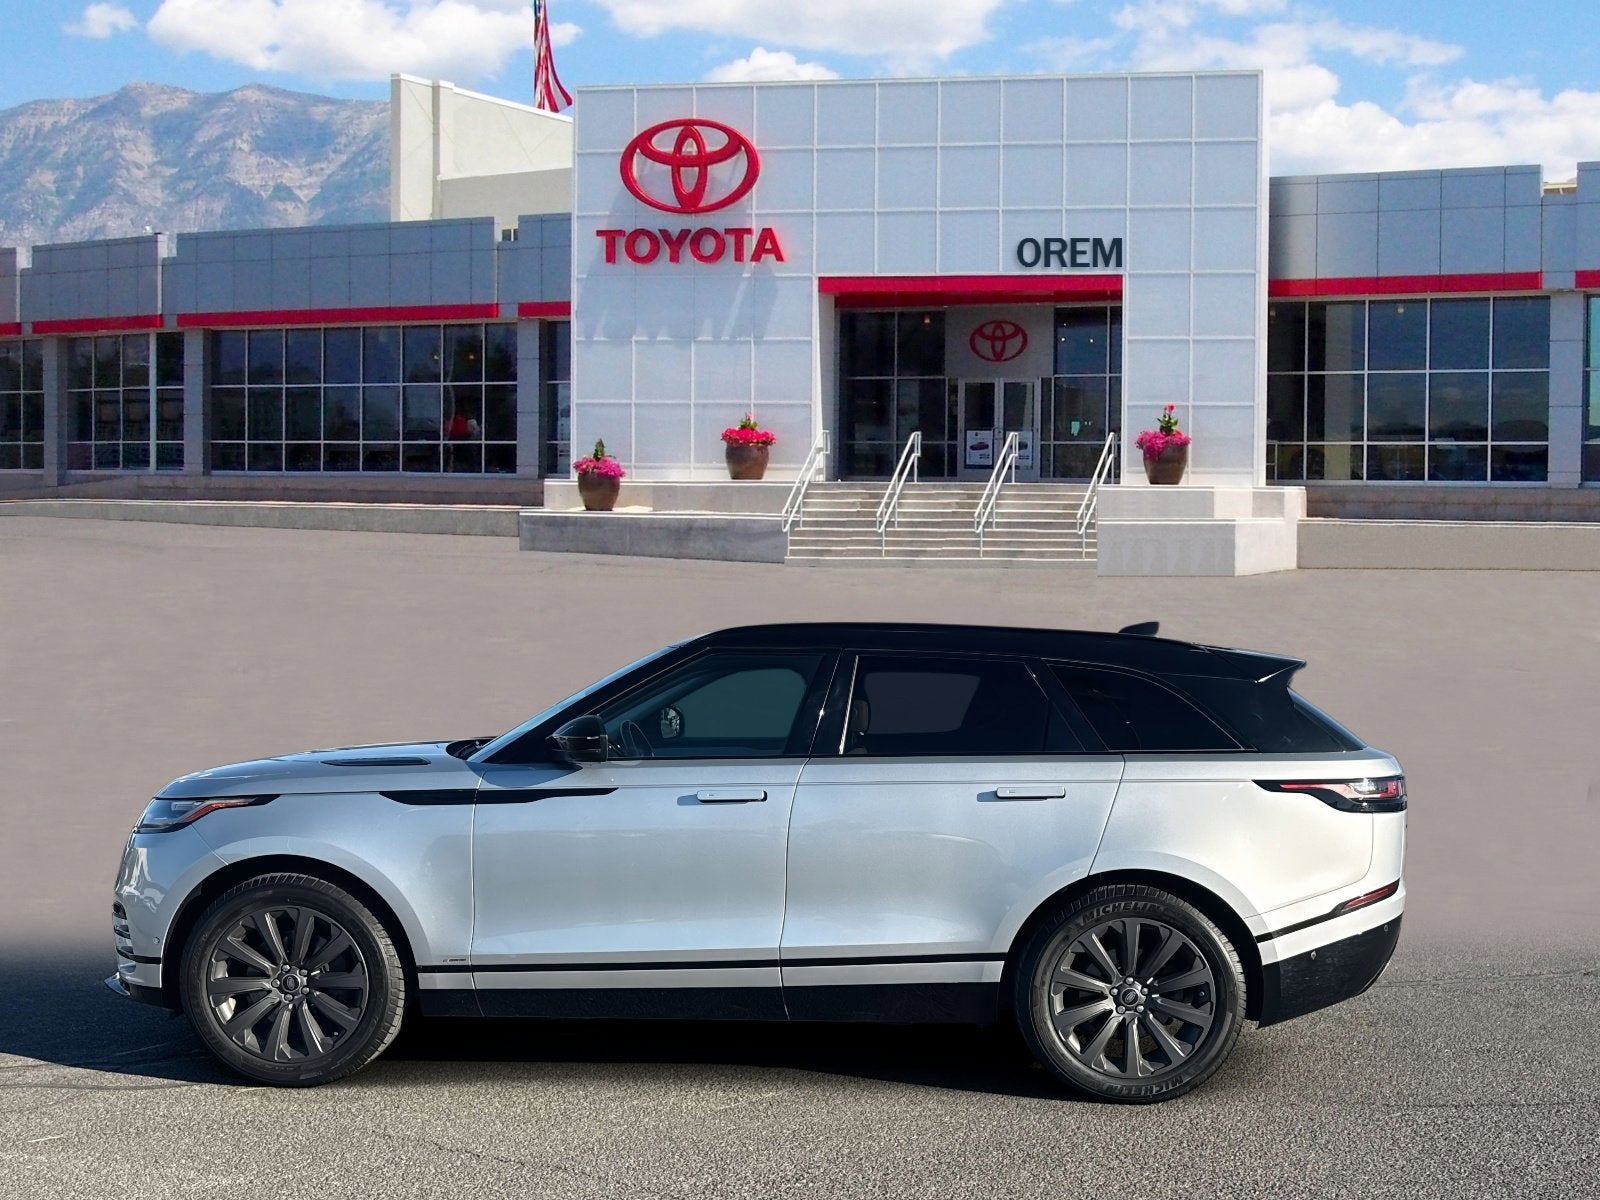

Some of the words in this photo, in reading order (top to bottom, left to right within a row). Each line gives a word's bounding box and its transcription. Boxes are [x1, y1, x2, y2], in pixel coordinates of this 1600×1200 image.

[597, 227, 785, 263] TOYOTA
[1016, 237, 1123, 268] OREM
[1081, 901, 1160, 925] MICHELIN
